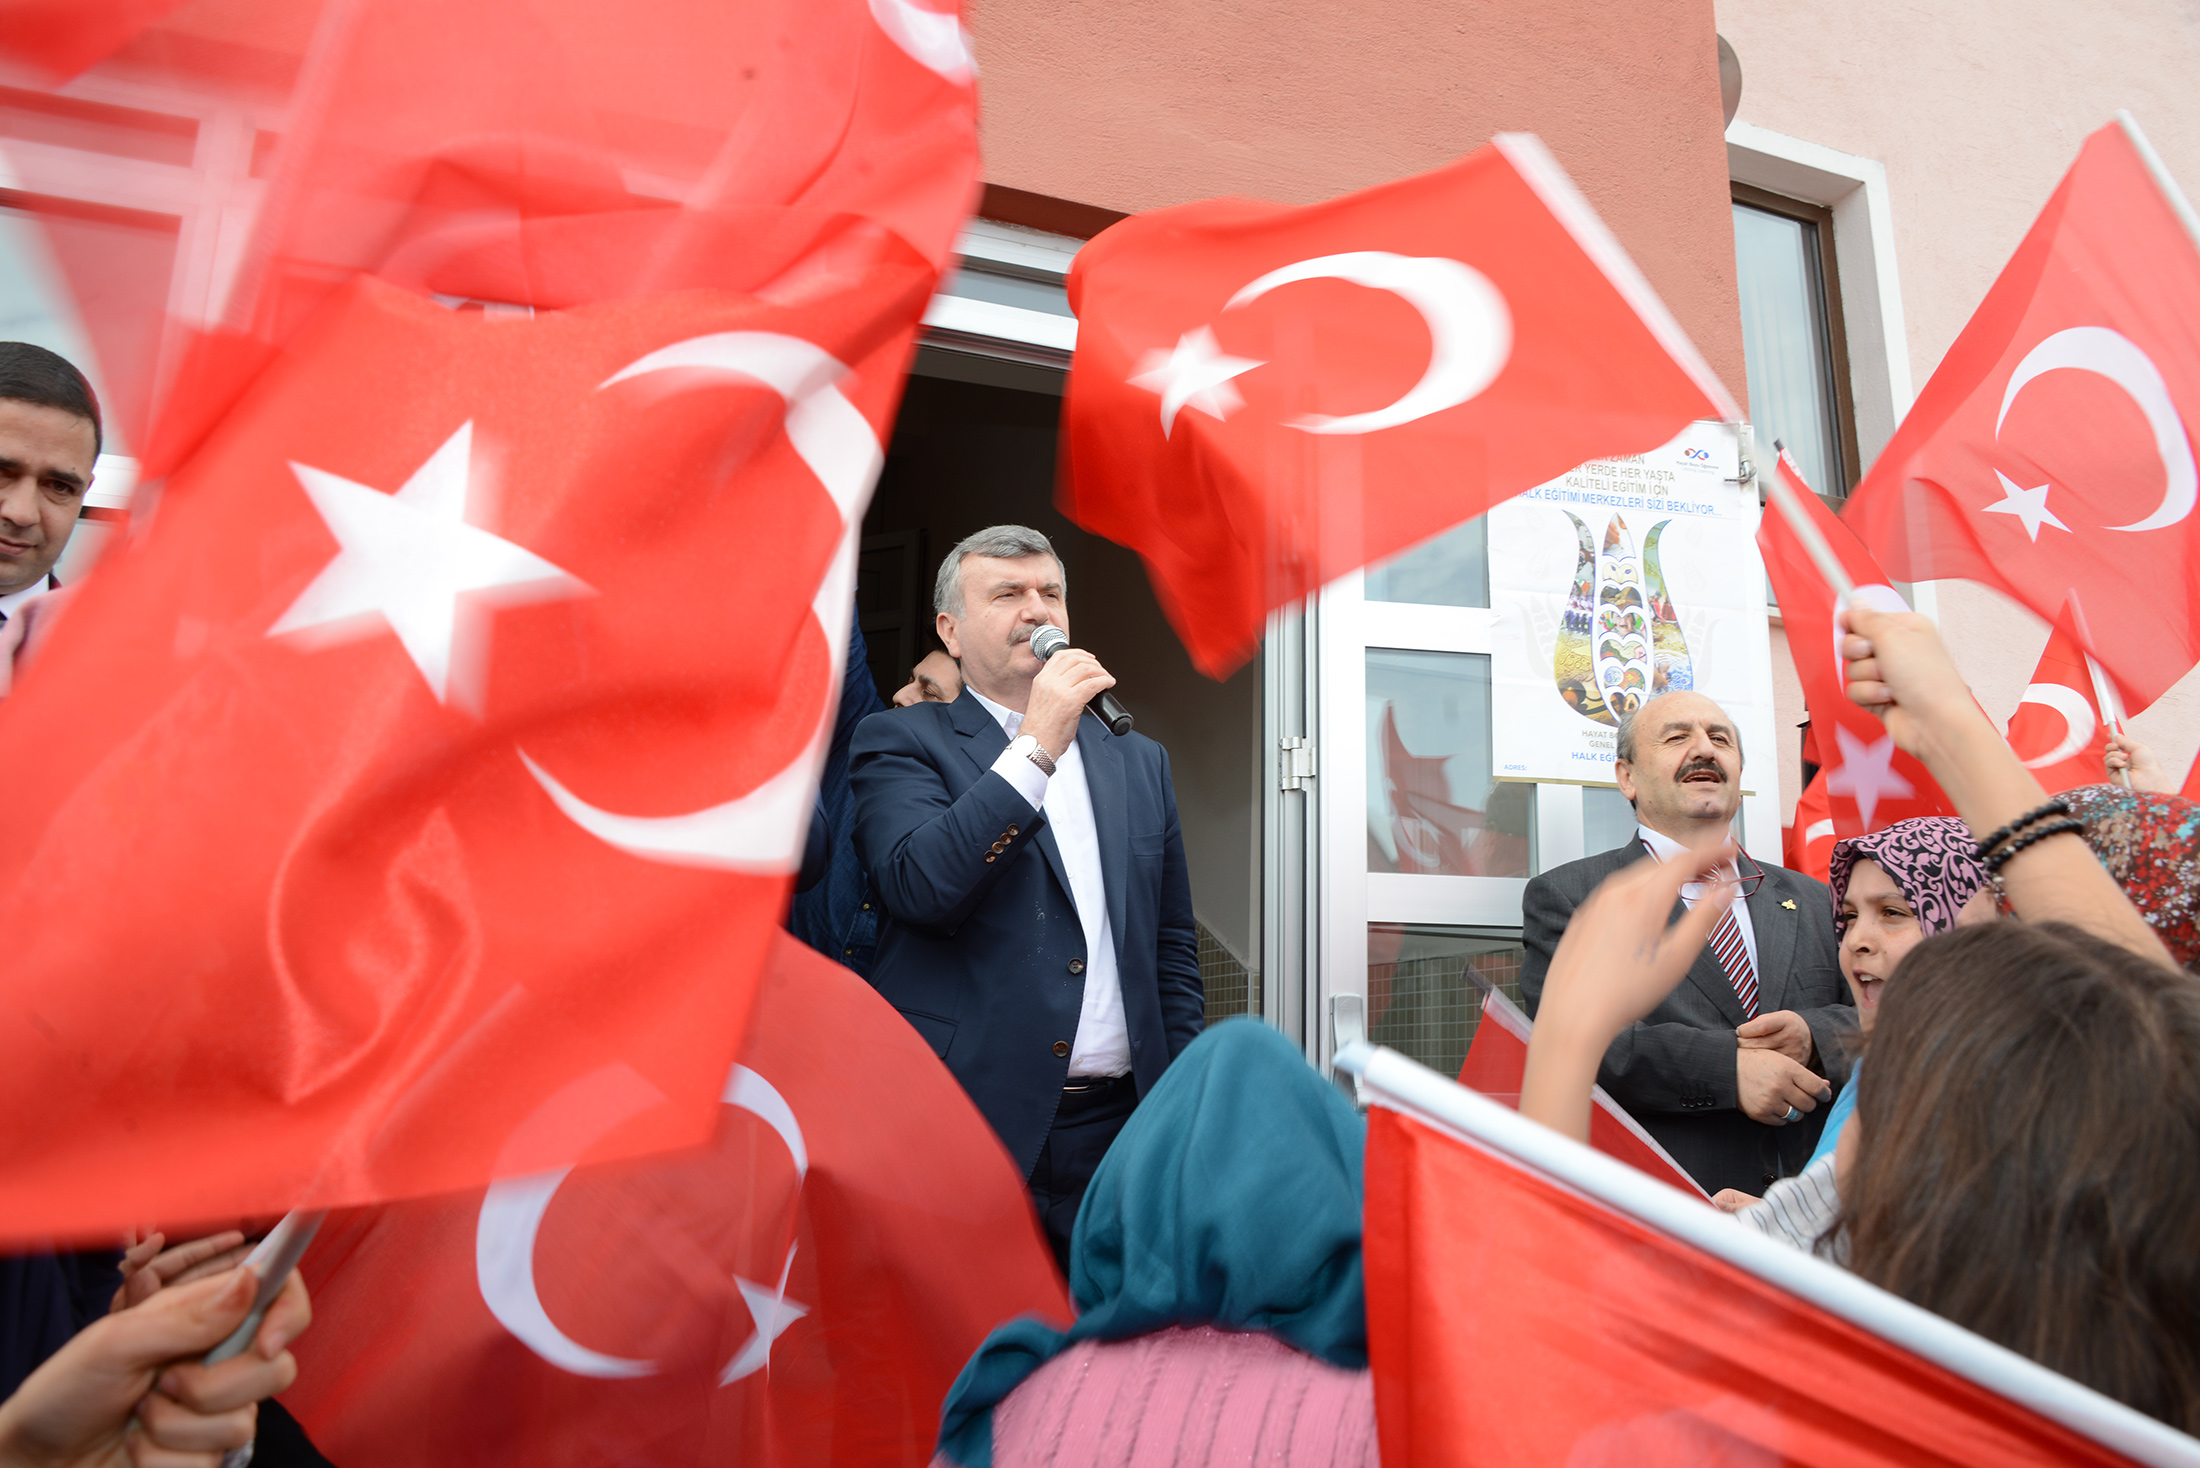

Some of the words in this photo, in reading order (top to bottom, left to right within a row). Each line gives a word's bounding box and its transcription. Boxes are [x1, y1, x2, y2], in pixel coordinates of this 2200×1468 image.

[1585, 463, 1617, 477] YERDE
[1620, 467, 1641, 479] HER
[1643, 469, 1675, 482] YAŞTA
[1565, 475, 1610, 490] KALİTELİ
[1612, 479, 1646, 494] EĞİTİM
[1648, 481, 1669, 497] İÇİN
[1544, 487, 1581, 503] EĞİTİMİ
[1582, 492, 1644, 508] MERKEZLERİ
[1646, 496, 1665, 510] SİZİ
[1581, 730, 1607, 738] HAYAT
[1588, 740, 1615, 749] GENEL
[1571, 751, 1598, 761] HALK
